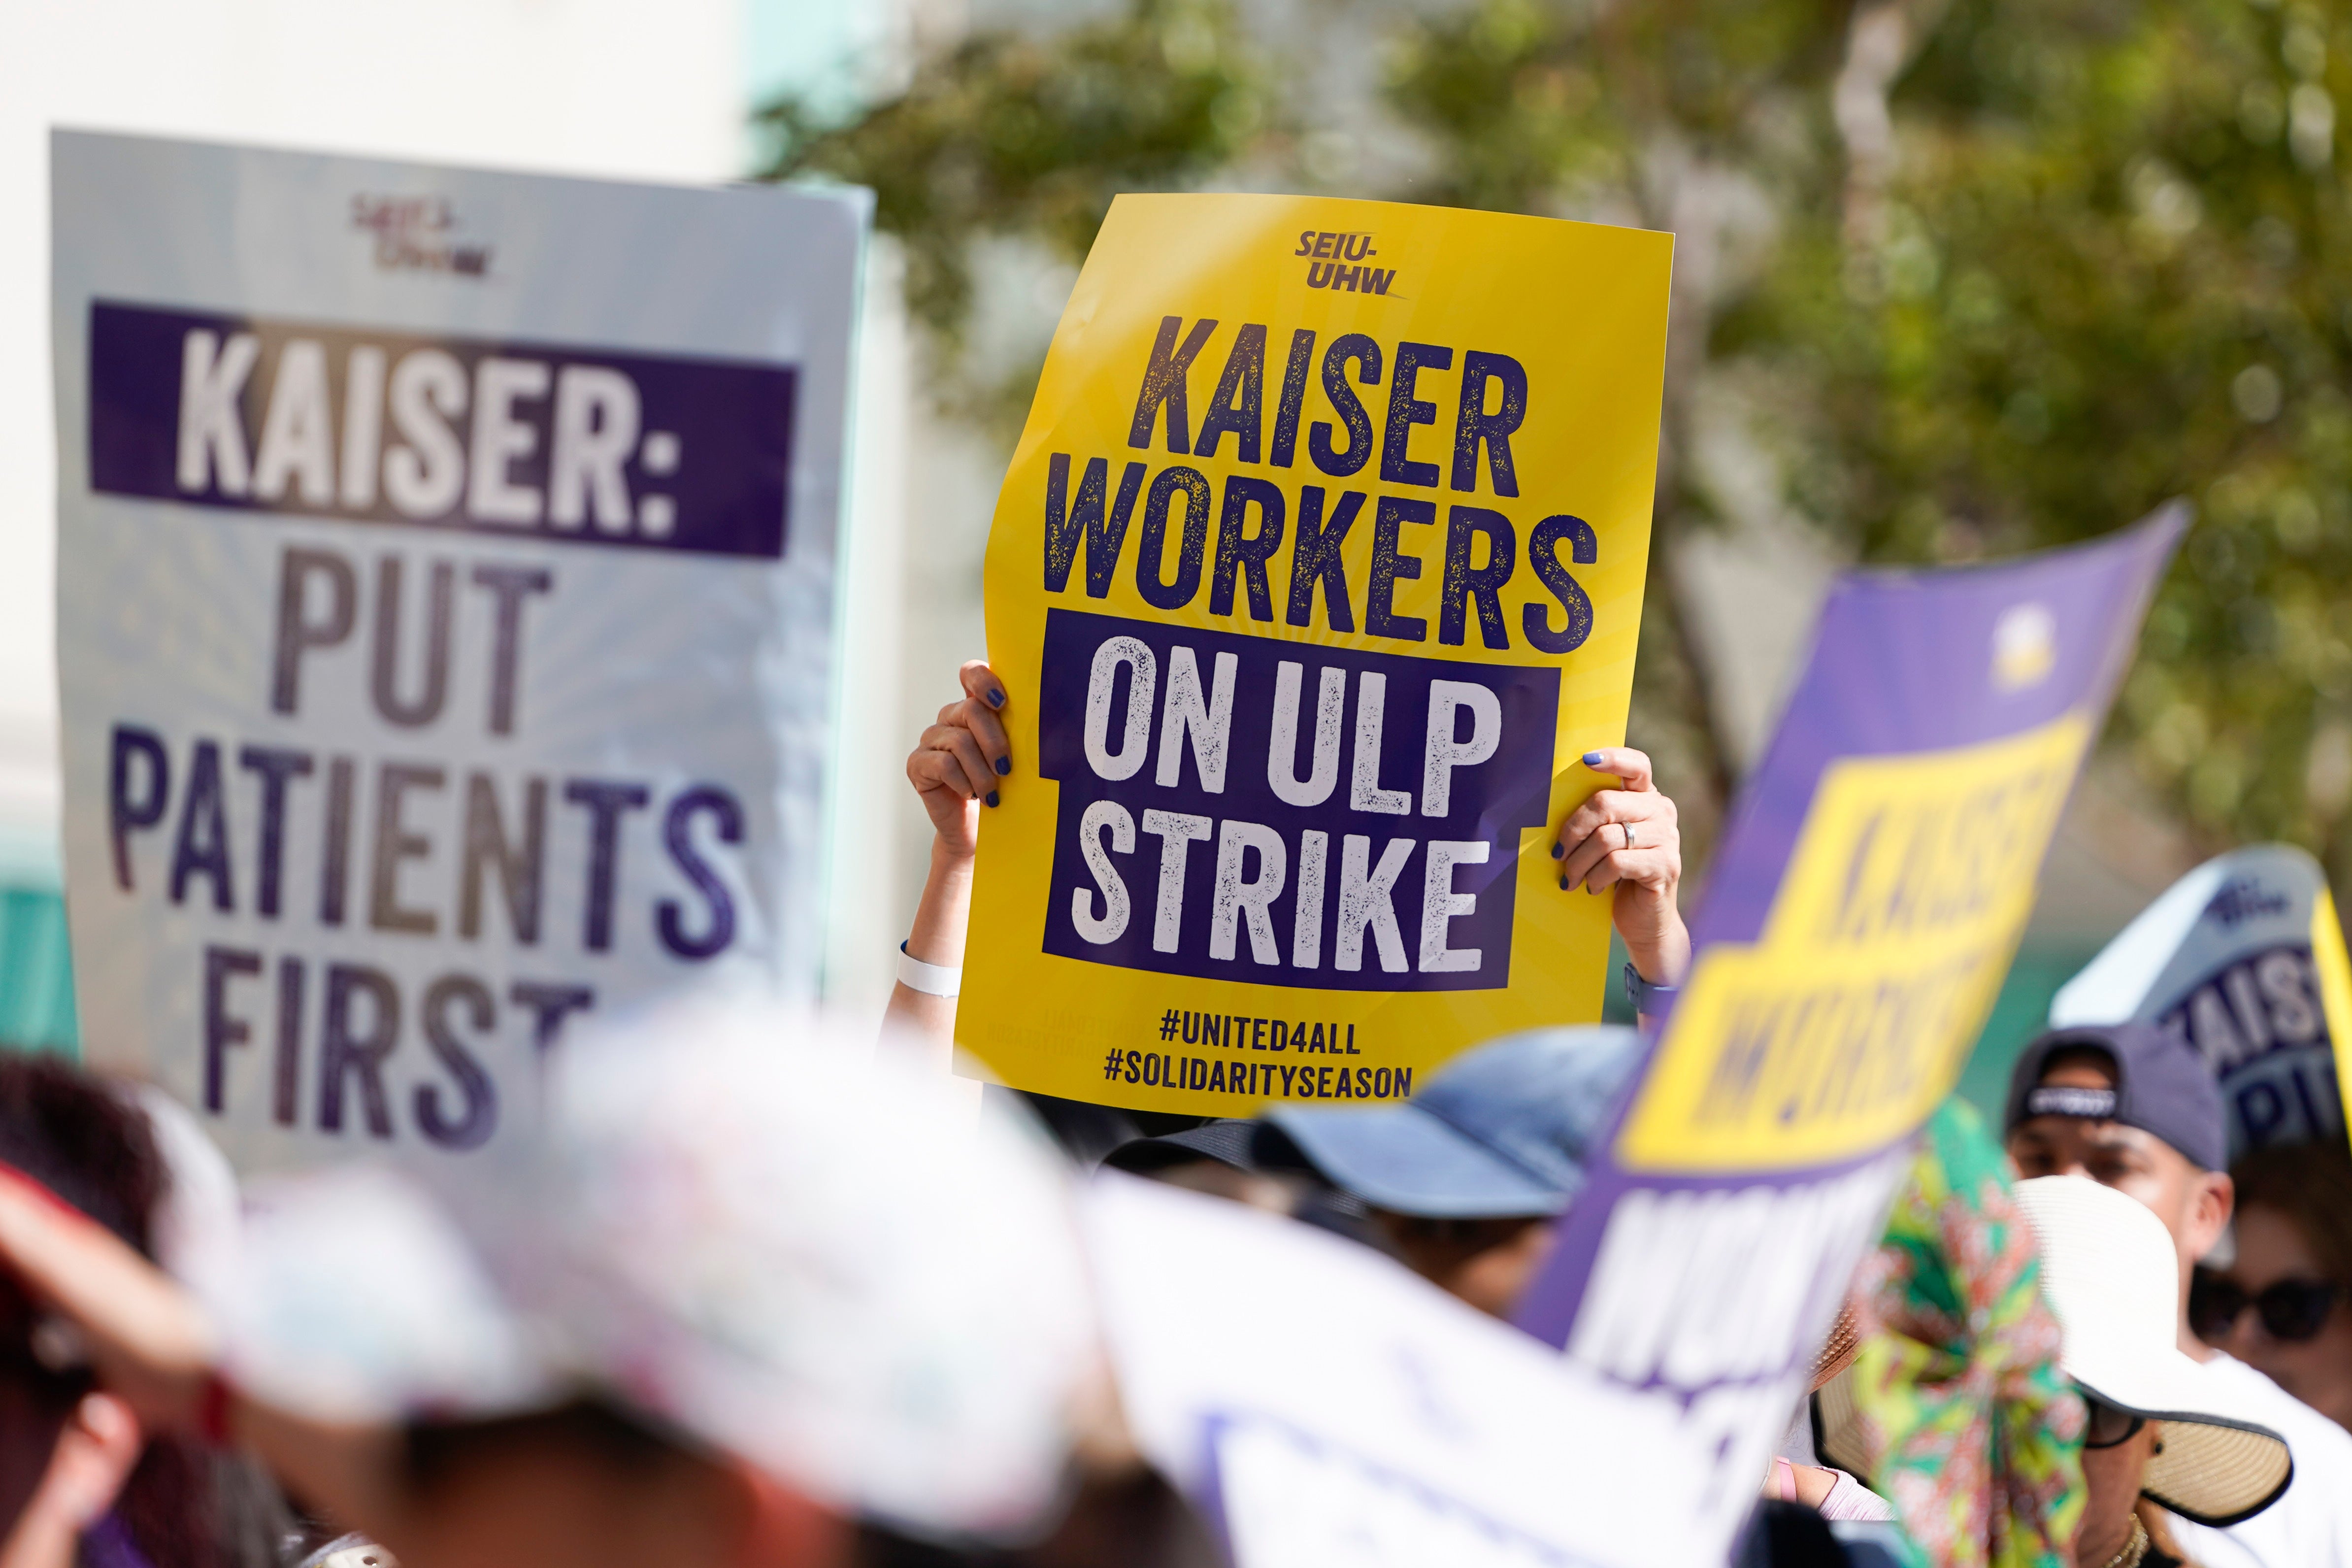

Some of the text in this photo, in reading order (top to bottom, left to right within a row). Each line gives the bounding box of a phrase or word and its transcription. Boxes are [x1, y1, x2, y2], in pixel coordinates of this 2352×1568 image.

[1294, 231, 1377, 262] SEIU-
[1306, 262, 1397, 296] UHW
[175, 328, 682, 537] KAISER:
[1127, 315, 1528, 498] KAISER
[271, 545, 558, 737] PUT
[1043, 452, 1598, 654] WORKERS
[1083, 635, 1502, 818] ON ULP
[107, 723, 747, 963] PATIENTS
[1070, 800, 1491, 973] STRIKE
[201, 943, 597, 1154] FIRST
[1103, 1047, 1413, 1098] #SOLIDARITYSEASON
[1159, 1008, 1361, 1055] #UNITED4ALL
